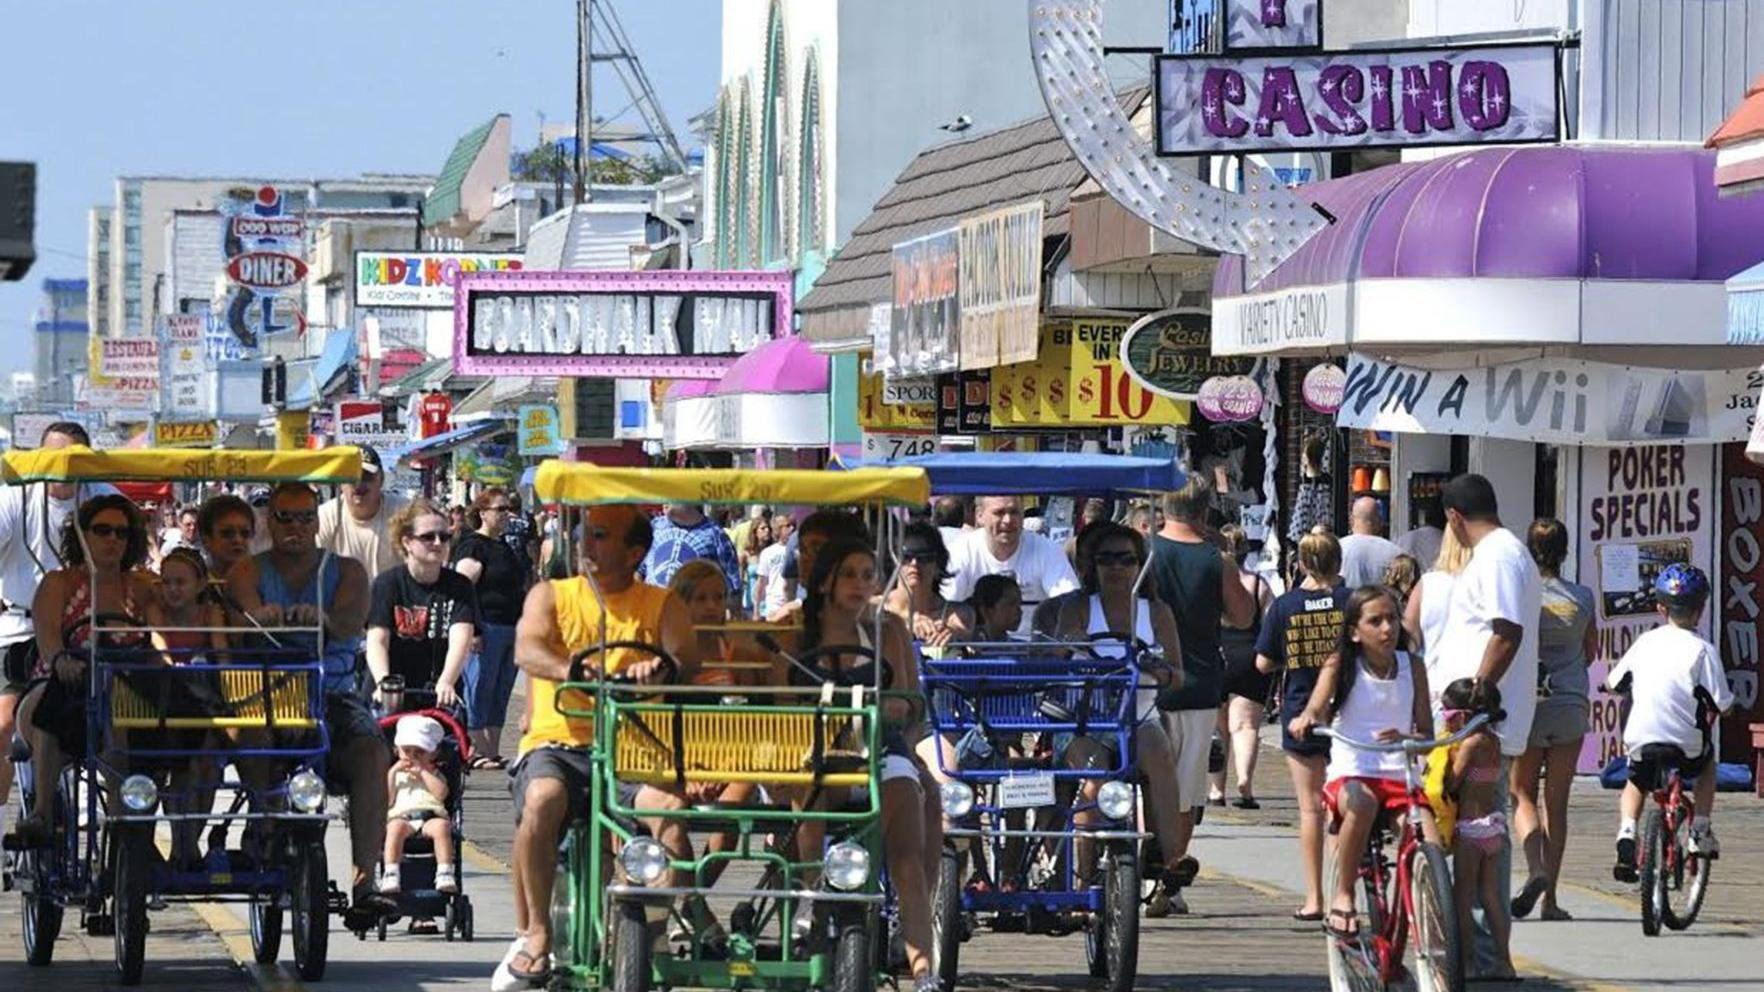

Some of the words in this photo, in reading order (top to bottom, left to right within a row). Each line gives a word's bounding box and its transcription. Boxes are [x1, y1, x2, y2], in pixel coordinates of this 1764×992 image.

[1201, 61, 1511, 138] CASINO
[240, 256, 297, 282] DINER
[361, 257, 422, 287] KIDZ
[475, 295, 683, 354] BOARDWALK
[1240, 299, 1280, 344] VARIETY
[1284, 292, 1327, 339] CASINO
[1093, 344, 1110, 360] IN
[887, 386, 936, 401] SPOR
[1342, 361, 1431, 416] WIN
[1438, 373, 1469, 419] A
[1486, 367, 1588, 433] Wii
[160, 423, 215, 438] PIZZA
[886, 439, 935, 461] 748
[1608, 445, 1685, 492] POKER
[1590, 488, 1700, 541] SPECIALS
[1304, 597, 1334, 611] BAKER
[1593, 699, 1624, 732] RO
